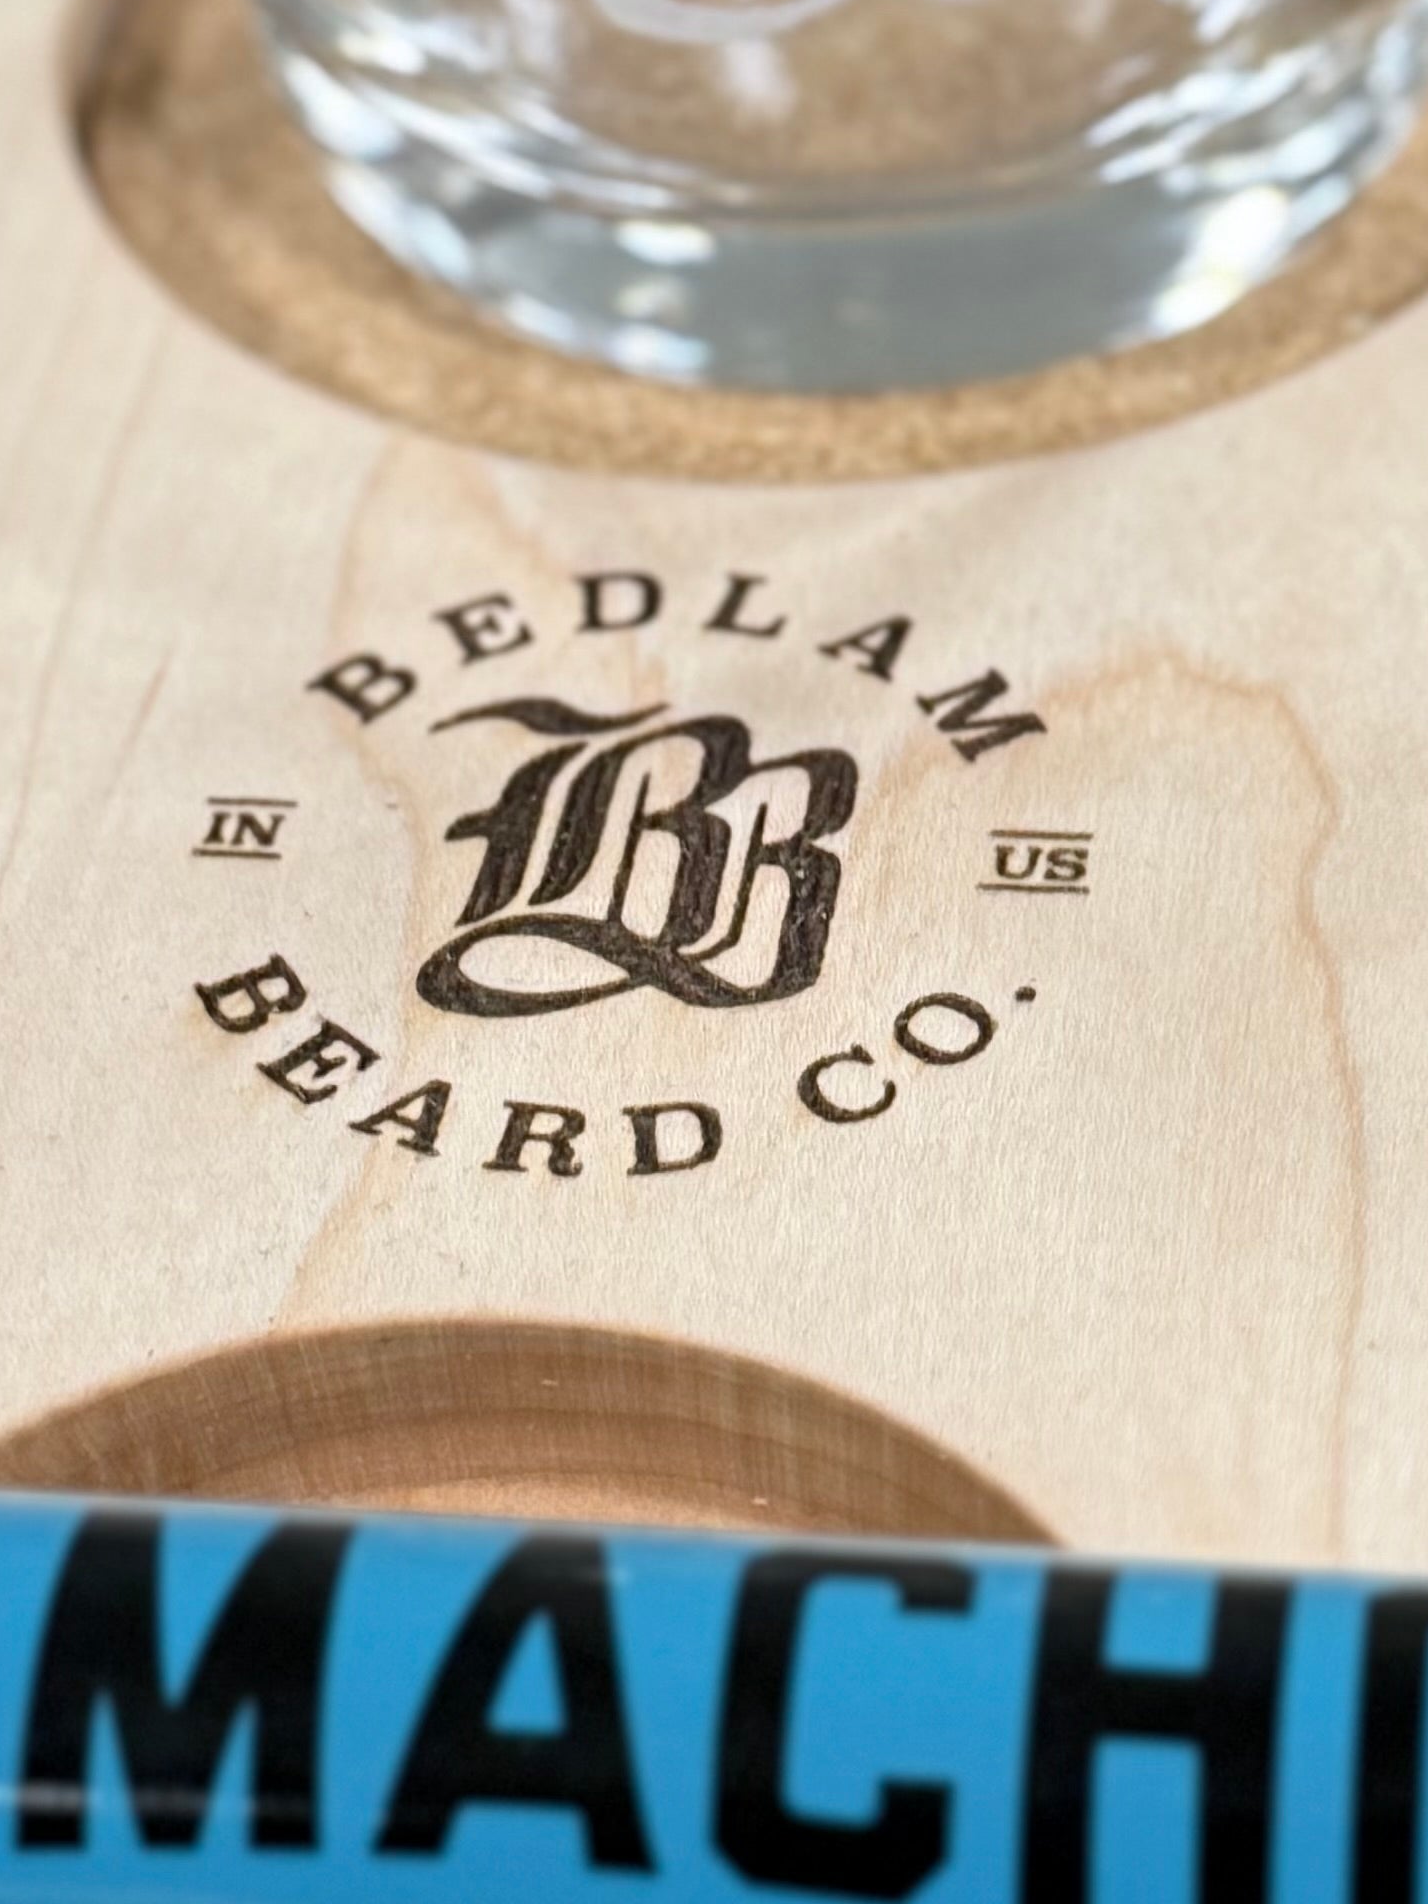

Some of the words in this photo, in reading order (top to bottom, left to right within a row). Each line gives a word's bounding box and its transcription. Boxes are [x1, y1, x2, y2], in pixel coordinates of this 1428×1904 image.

[305, 570, 1048, 764] BEDLAM
[202, 811, 287, 847] IN
[994, 844, 1090, 882] US
[193, 953, 724, 1178] BEARD
[795, 984, 1038, 1125] CO.
